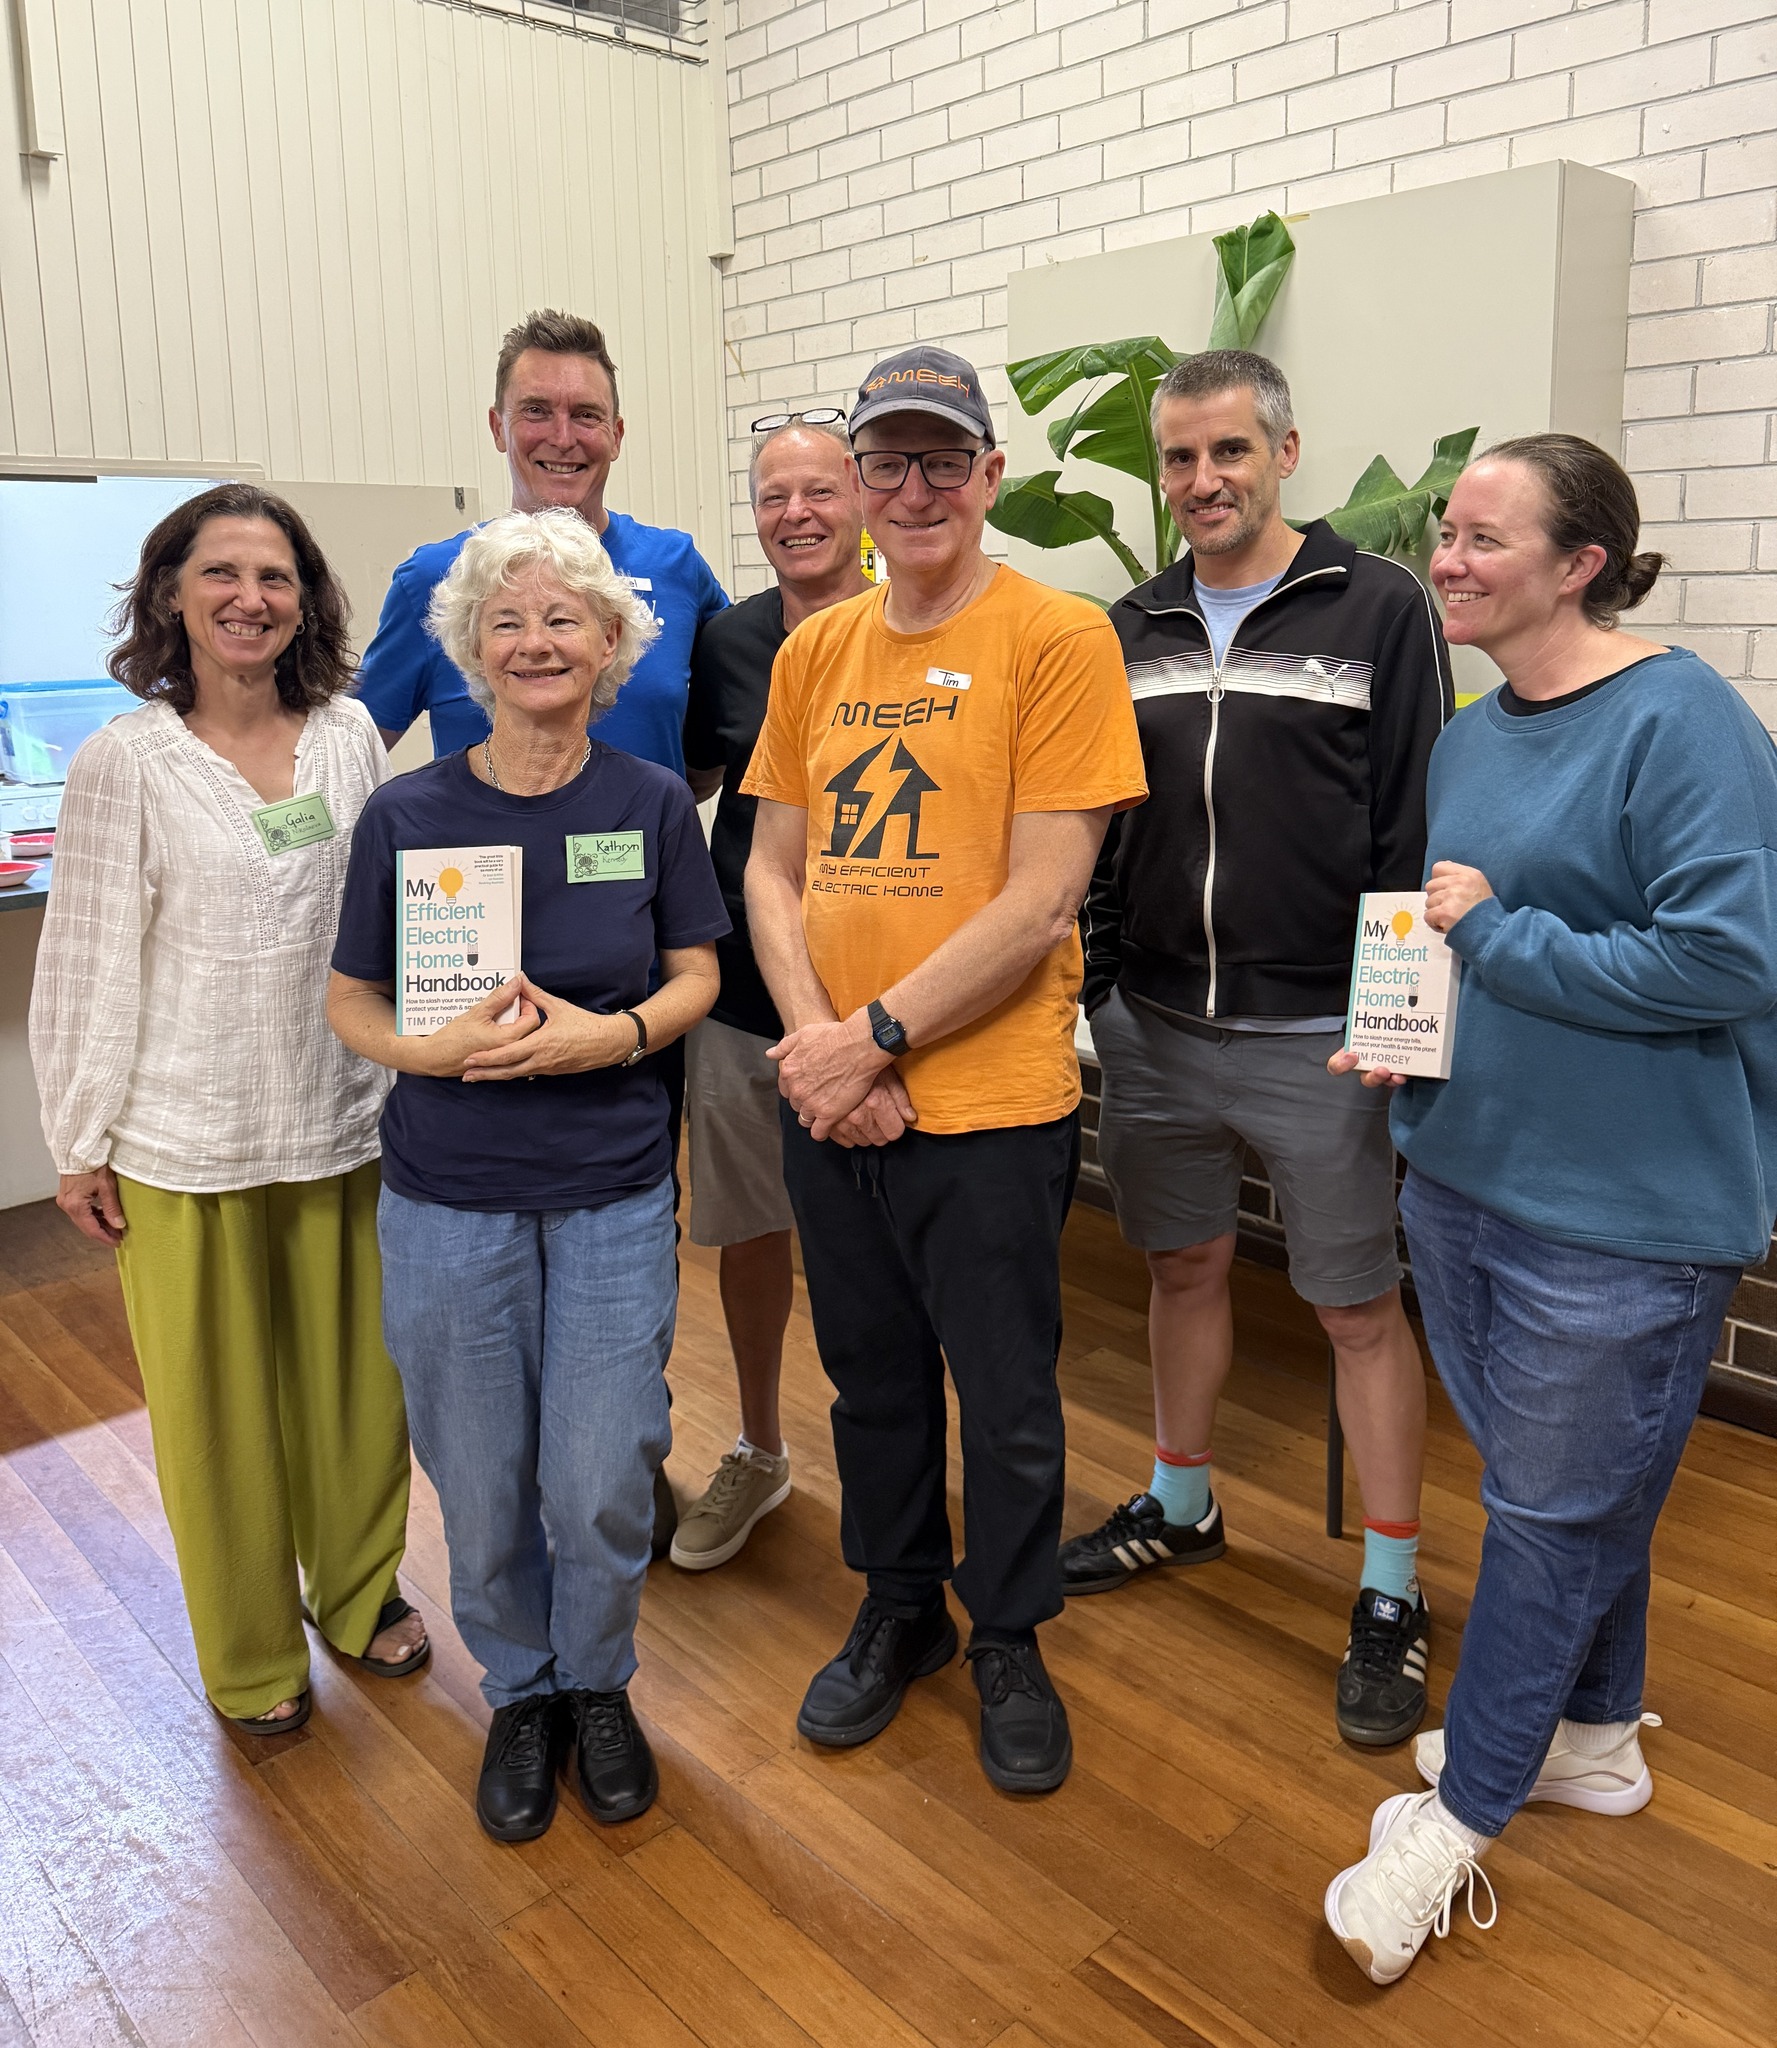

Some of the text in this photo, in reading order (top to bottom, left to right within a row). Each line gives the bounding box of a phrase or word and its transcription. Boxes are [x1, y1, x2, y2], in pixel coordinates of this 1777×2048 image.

[888, 368, 970, 398] MEEH
[938, 670, 959, 687] Tim
[830, 696, 959, 728] MEEH
[286, 812, 316, 828] Galia
[596, 840, 640, 860] Kathryn
[819, 863, 837, 875] MY
[406, 878, 435, 900] My
[883, 885, 944, 897] HOME
[406, 902, 485, 922] Efficient
[406, 926, 478, 945] Electric
[1363, 920, 1389, 941] My
[406, 951, 464, 969] Home
[1361, 943, 1428, 962] Efficient
[406, 972, 506, 992] Handbook
[1359, 966, 1420, 985] Electric
[1356, 988, 1405, 1008] Home
[406, 1016, 452, 1026] TIM FOR
[1354, 1010, 1439, 1034] Handbook
[1371, 1053, 1410, 1064] FORCEY
